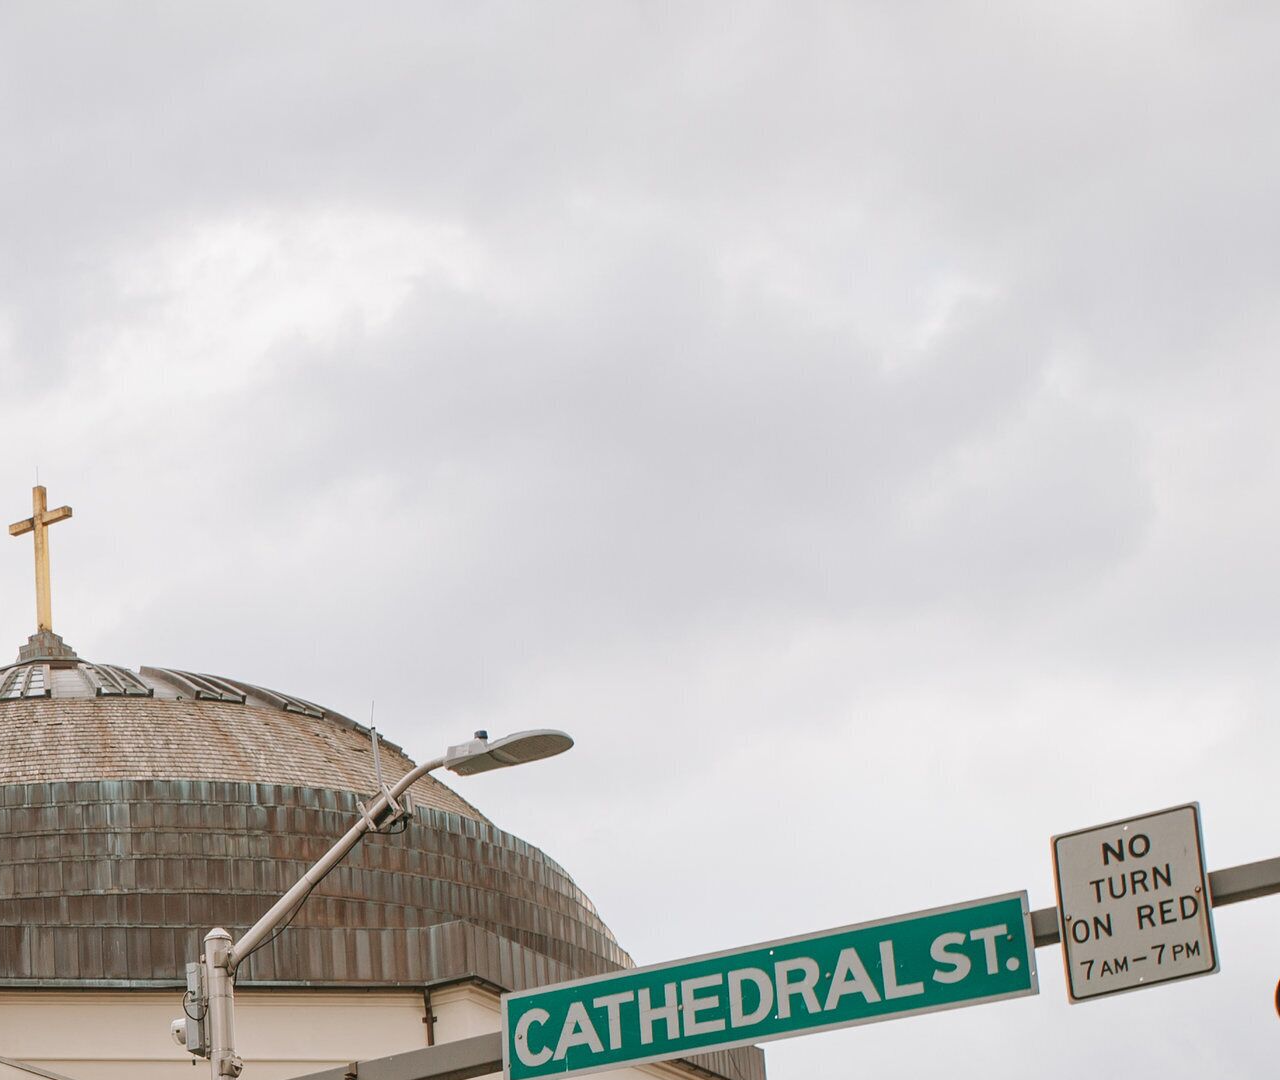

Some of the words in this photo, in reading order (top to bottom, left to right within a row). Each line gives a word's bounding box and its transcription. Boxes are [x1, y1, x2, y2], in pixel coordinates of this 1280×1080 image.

[1101, 833, 1151, 866] NO
[1089, 863, 1172, 903] TURN
[1072, 913, 1113, 944] ON
[1137, 895, 1199, 930] RED
[514, 940, 925, 1067] CATHEDRAL
[932, 923, 1021, 985] ST.
